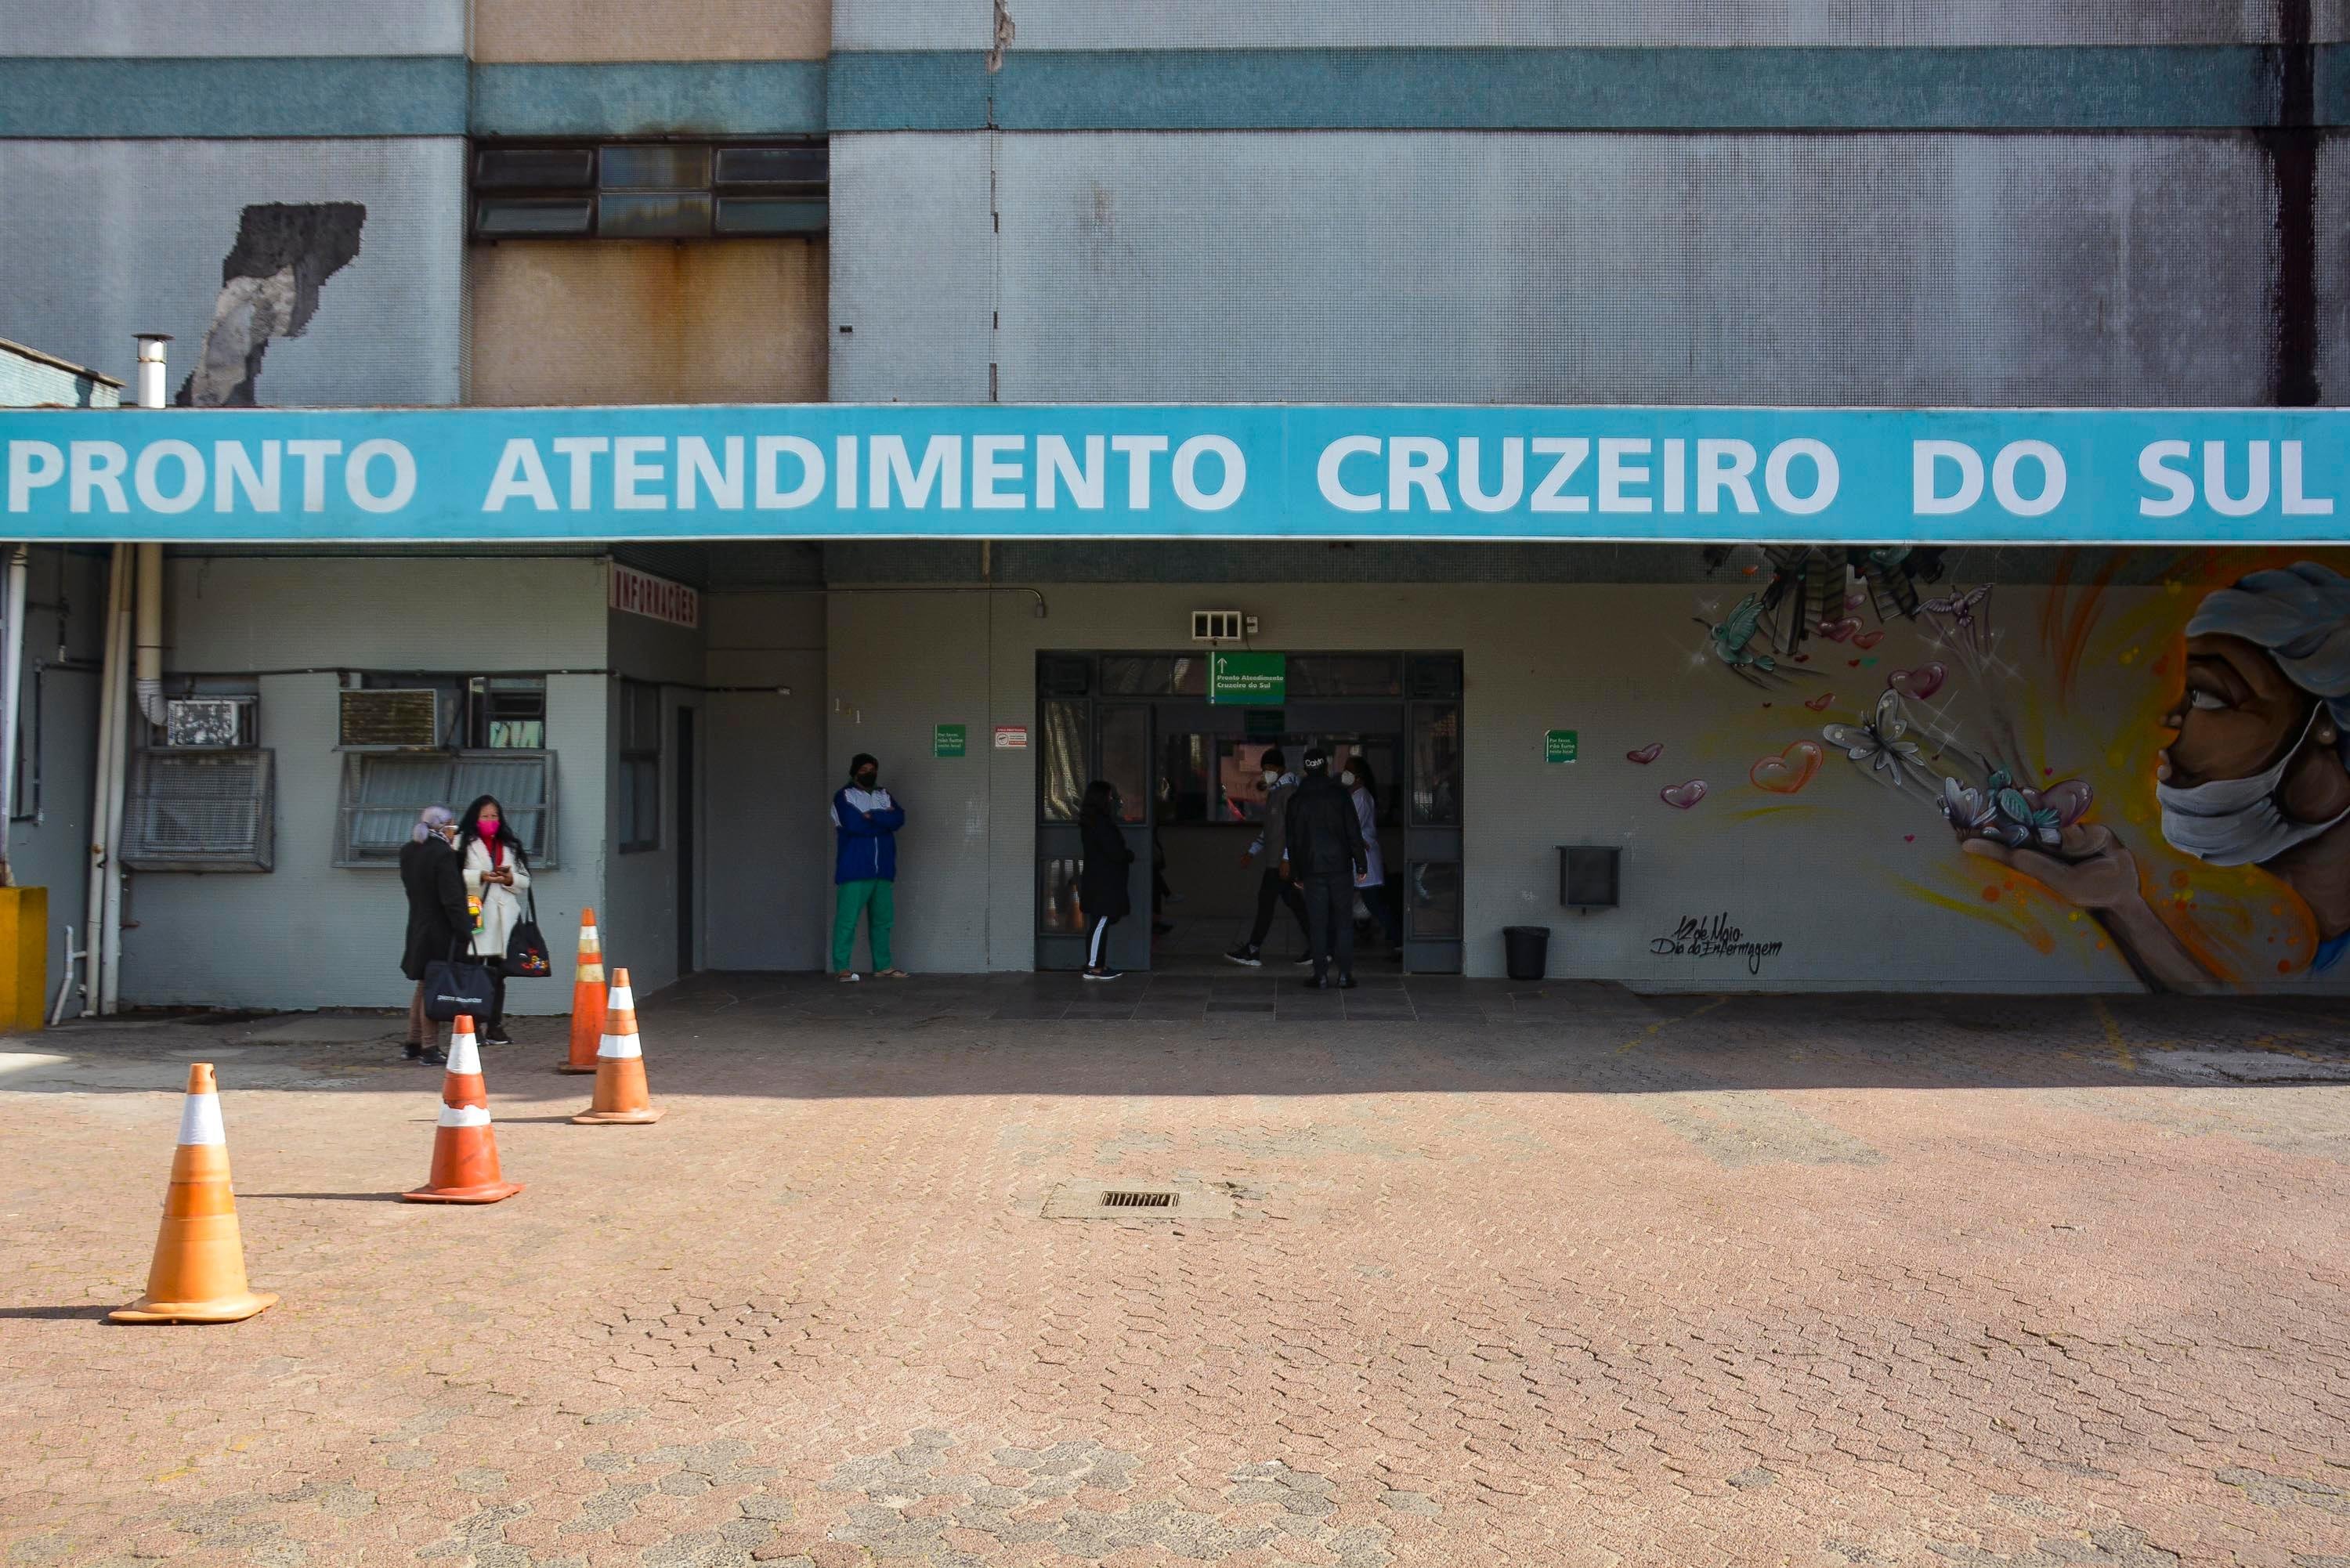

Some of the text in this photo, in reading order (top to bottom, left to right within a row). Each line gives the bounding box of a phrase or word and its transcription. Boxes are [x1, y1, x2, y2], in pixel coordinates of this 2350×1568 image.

[8, 434, 2334, 518] PRONTO ATENDIMENTO CRUZEIRO DO SUL
[615, 569, 695, 623] INFORMAÇÕES
[1694, 915, 1709, 940] de
[1650, 938, 1783, 975] Dia da Enfermagem
